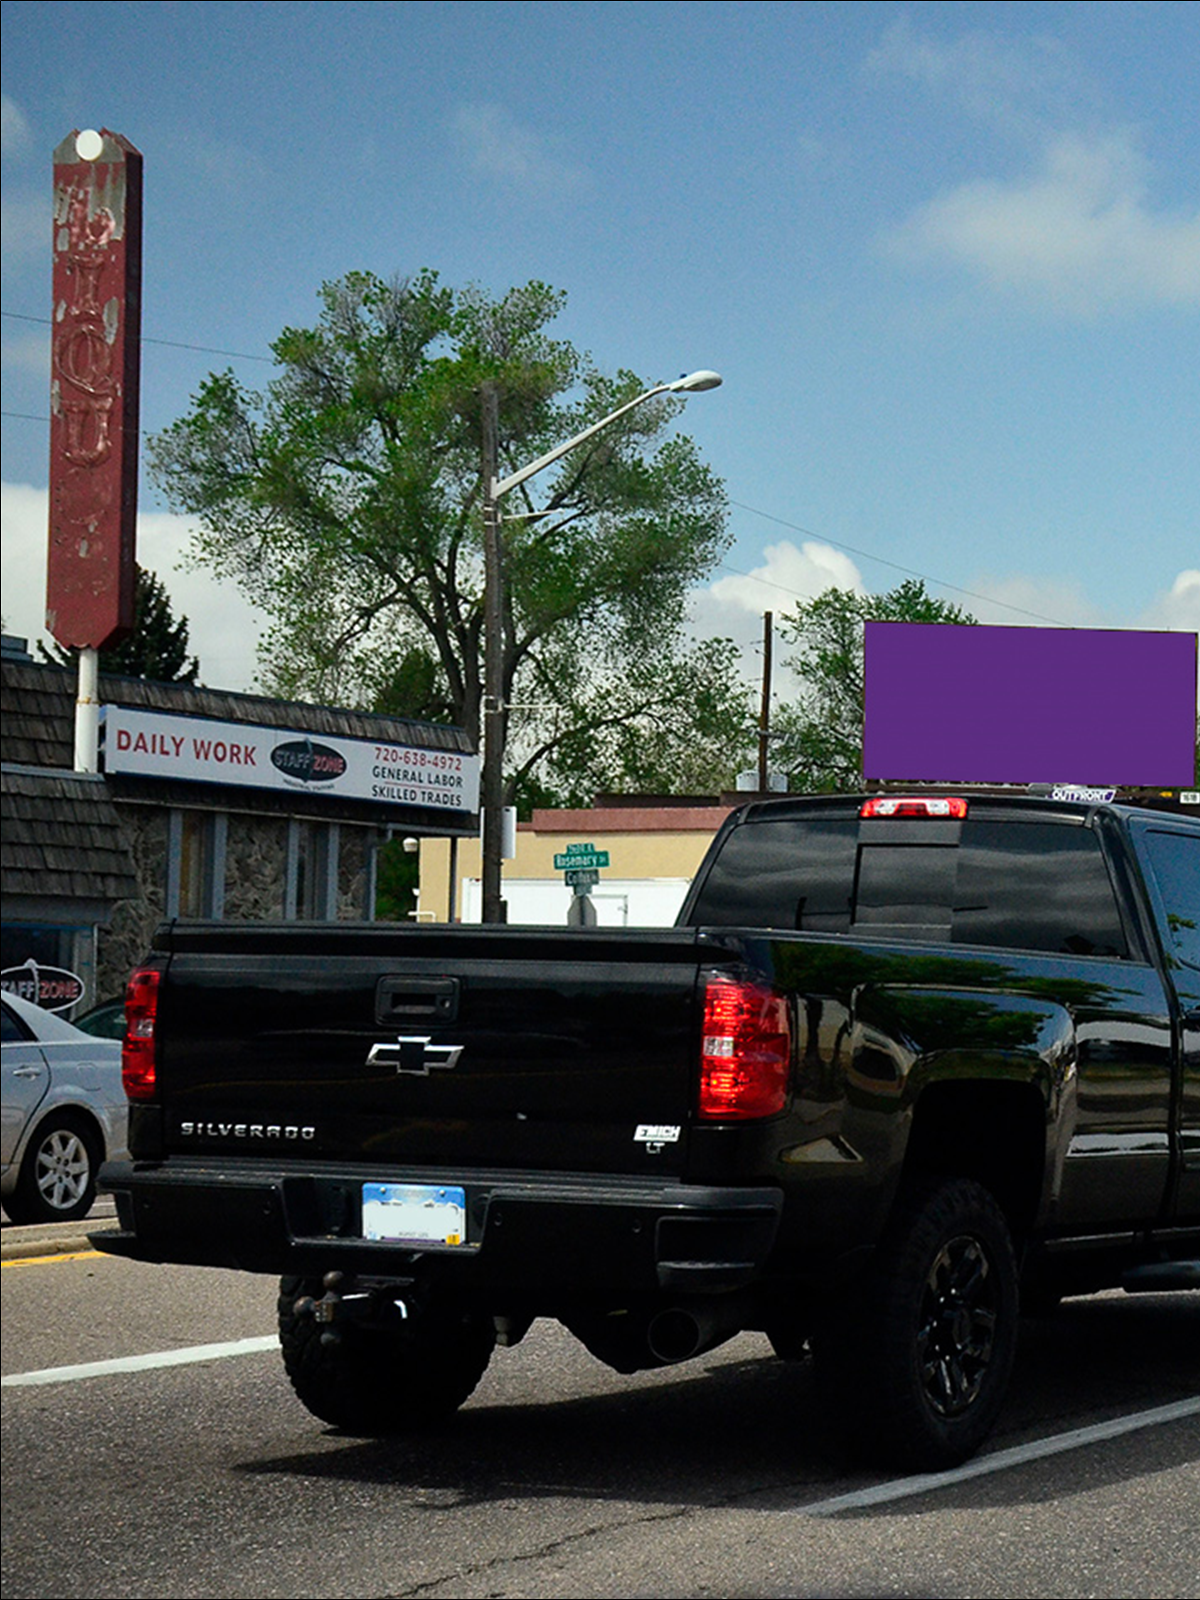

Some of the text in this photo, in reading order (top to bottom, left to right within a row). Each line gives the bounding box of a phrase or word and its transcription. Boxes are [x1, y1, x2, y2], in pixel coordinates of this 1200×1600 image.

[116, 729, 257, 766] DAILY WORK
[374, 746, 462, 772] 720-638-4972
[313, 754, 344, 774] ZONE
[372, 765, 463, 789] GENERAL LABOR
[372, 784, 462, 807] SKILLED TRADES
[39, 981, 78, 998] ZONE
[181, 1122, 315, 1139] SILVERADO
